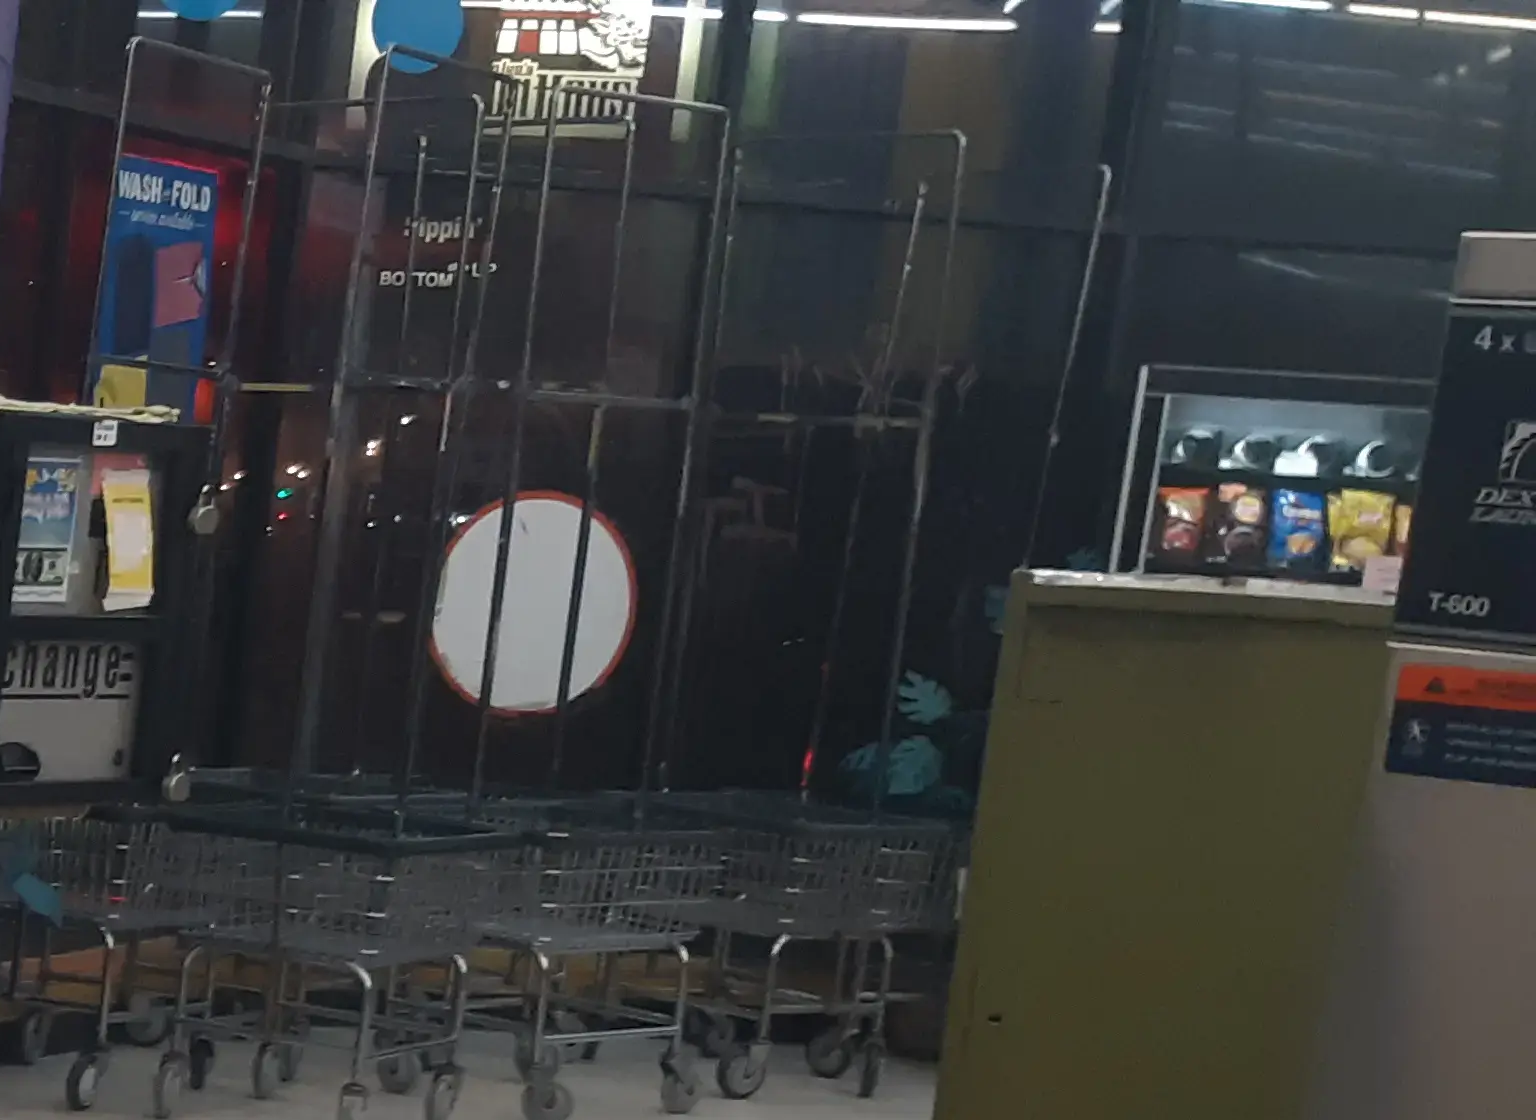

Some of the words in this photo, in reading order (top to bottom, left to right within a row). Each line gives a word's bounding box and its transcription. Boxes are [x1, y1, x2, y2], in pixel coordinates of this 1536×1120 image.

[118, 169, 164, 205] WASH
[170, 180, 211, 212] FOLD
[1473, 325, 1494, 350] 4
[1429, 590, 1490, 617] T-600
